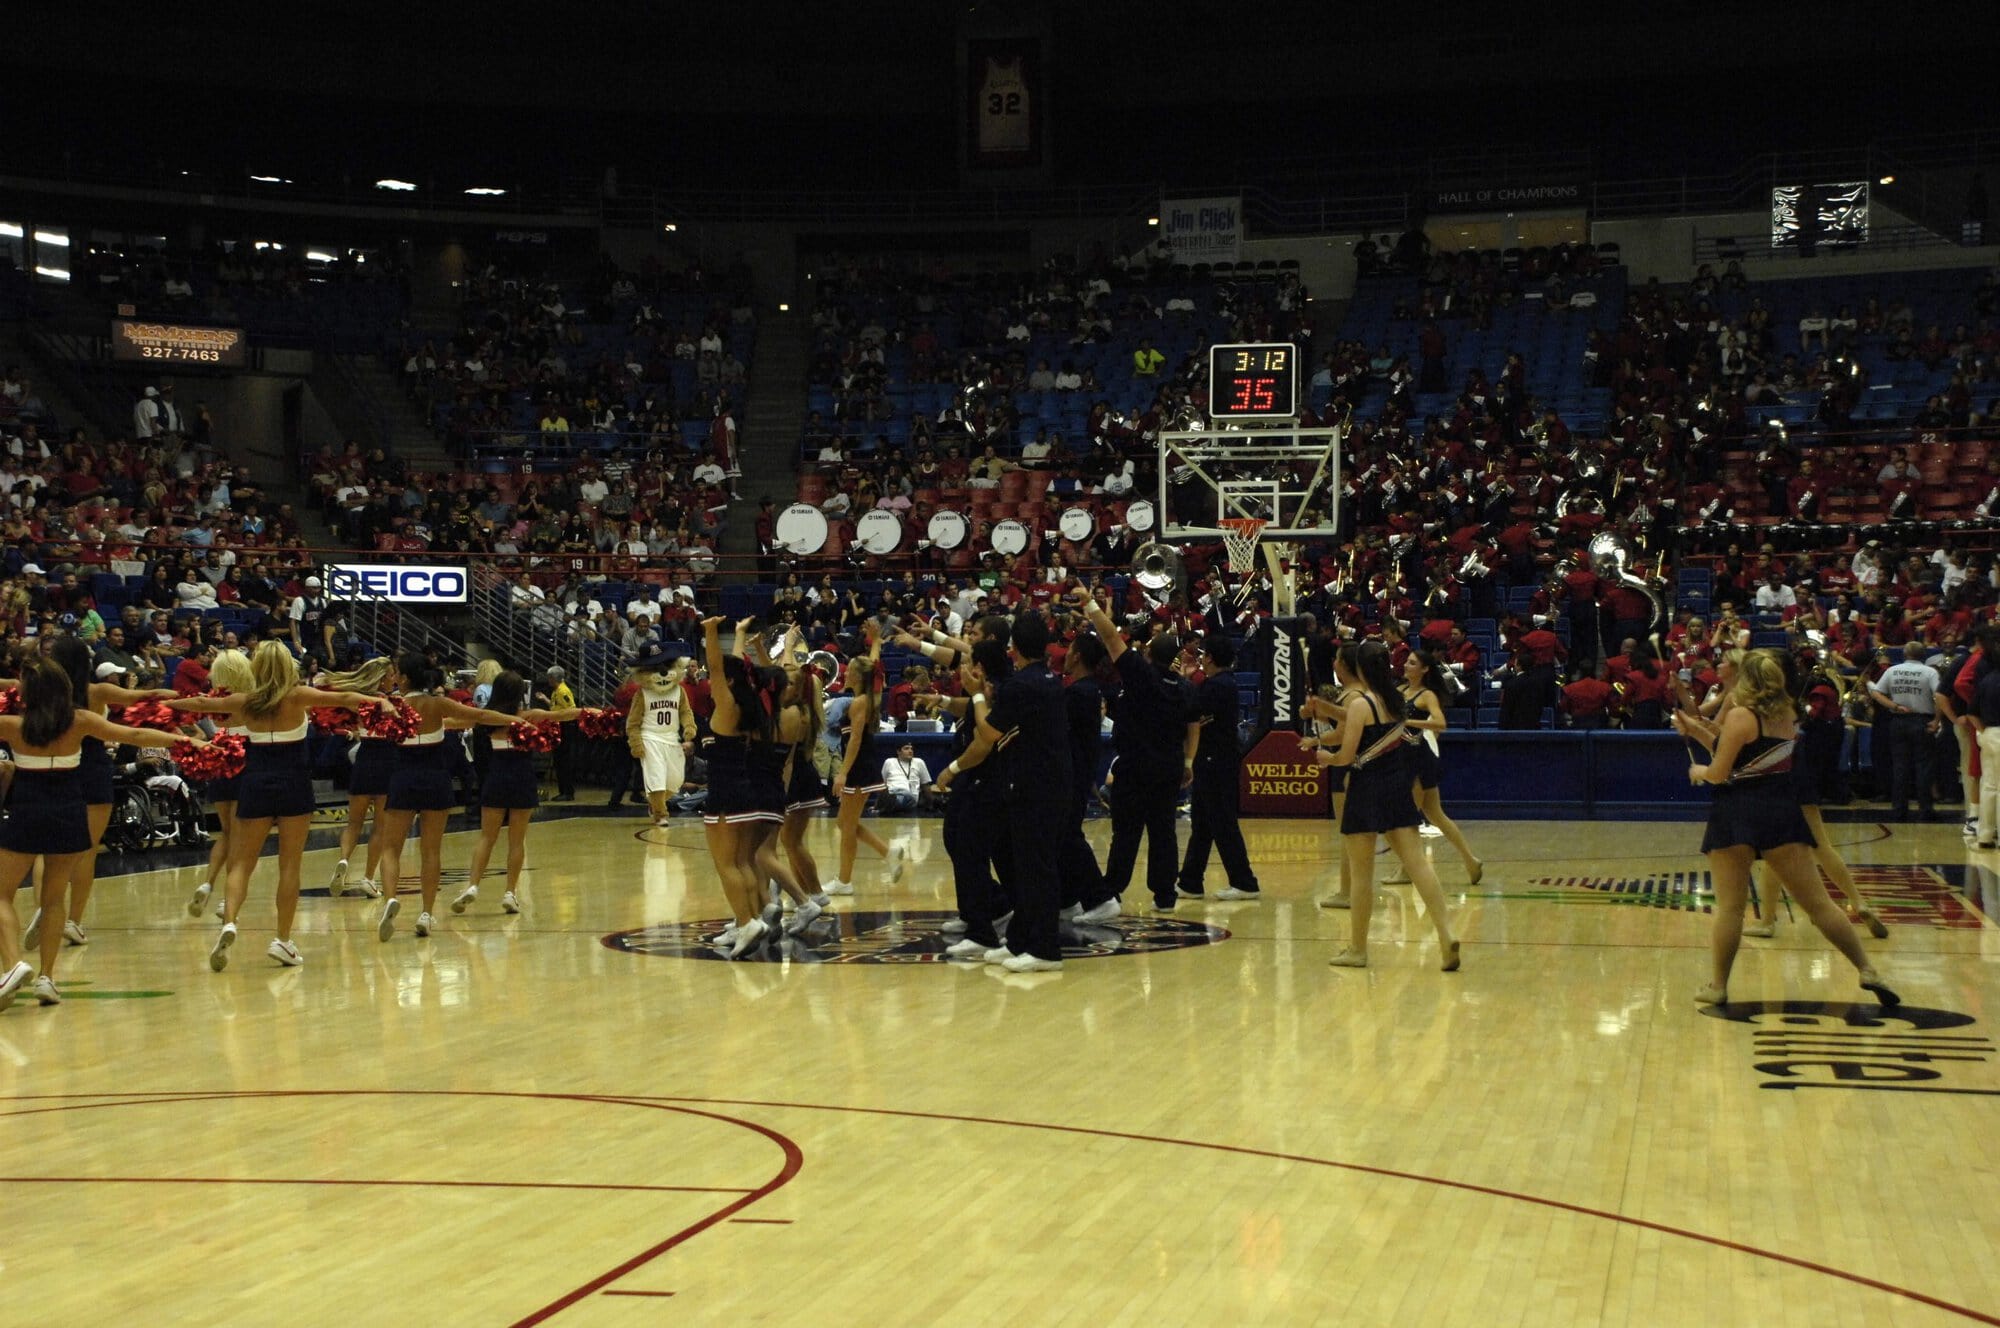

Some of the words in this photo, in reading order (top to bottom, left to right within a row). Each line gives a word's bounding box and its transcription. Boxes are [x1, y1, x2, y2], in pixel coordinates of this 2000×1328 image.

[988, 93, 1020, 115] 32
[1438, 192, 1472, 204] HALL
[1476, 190, 1494, 201] OF
[1497, 185, 1578, 200] CHAMPIONS
[1167, 209, 1194, 233] Jim
[1199, 207, 1235, 231] Click
[142, 346, 220, 362] 327-7463
[1234, 351, 1286, 371] 3:12
[1229, 377, 1276, 411] 35
[1921, 433, 1936, 443] 22
[521, 464, 532, 474] 19
[571, 559, 583, 569] 19
[330, 570, 464, 597] GEICO
[1272, 625, 1291, 722] ARIZONA
[649, 700, 678, 711] ARIZONA
[657, 711, 671, 725] 00
[1246, 763, 1320, 779] WELLS
[1248, 780, 1320, 796] FARGO
